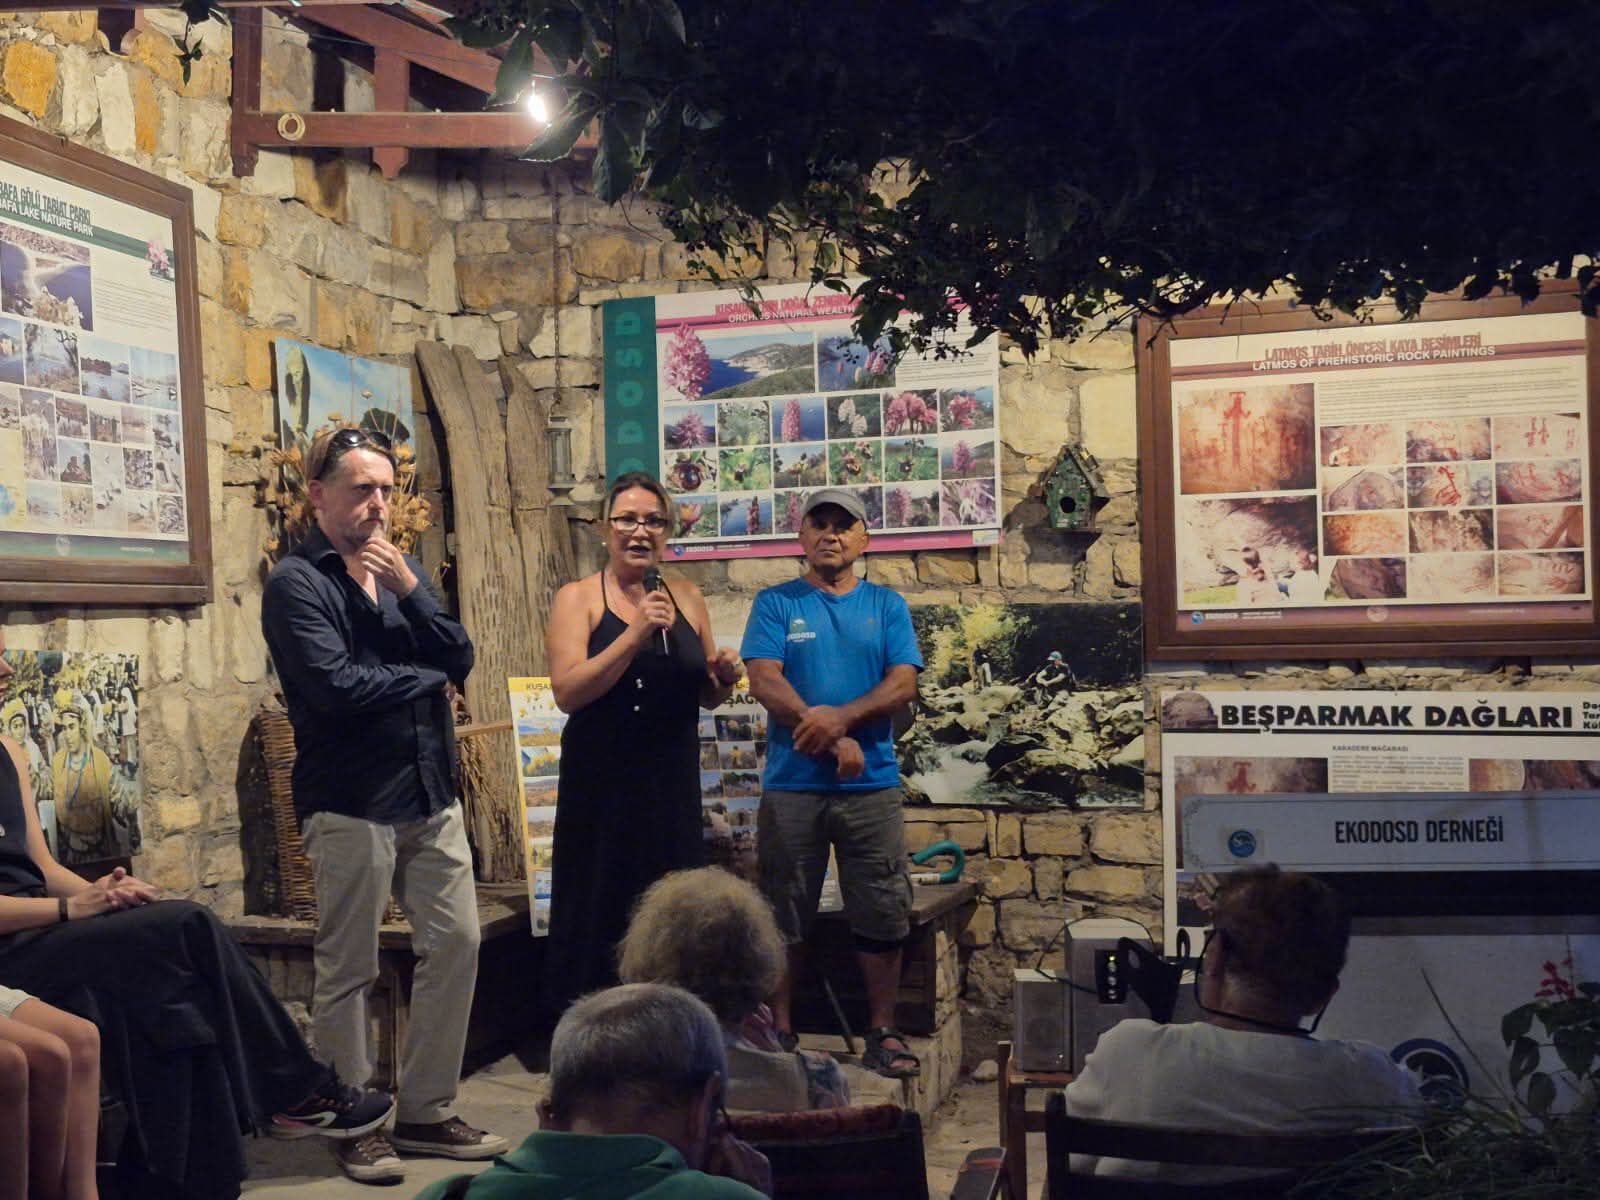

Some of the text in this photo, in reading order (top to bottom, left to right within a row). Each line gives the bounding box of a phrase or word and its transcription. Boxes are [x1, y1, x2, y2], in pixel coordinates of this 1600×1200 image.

[0, 197, 94, 237] AFA LAKE NATURE PARK
[772, 308, 815, 320] NATURAL
[1252, 345, 1496, 371] LATMOS OF PREHISTORIC ROCK PAINTINGS
[1221, 699, 1573, 732] BEŞPARMAK DAĞLARI
[1335, 815, 1504, 844] EKODOSD DERNEĞİ
